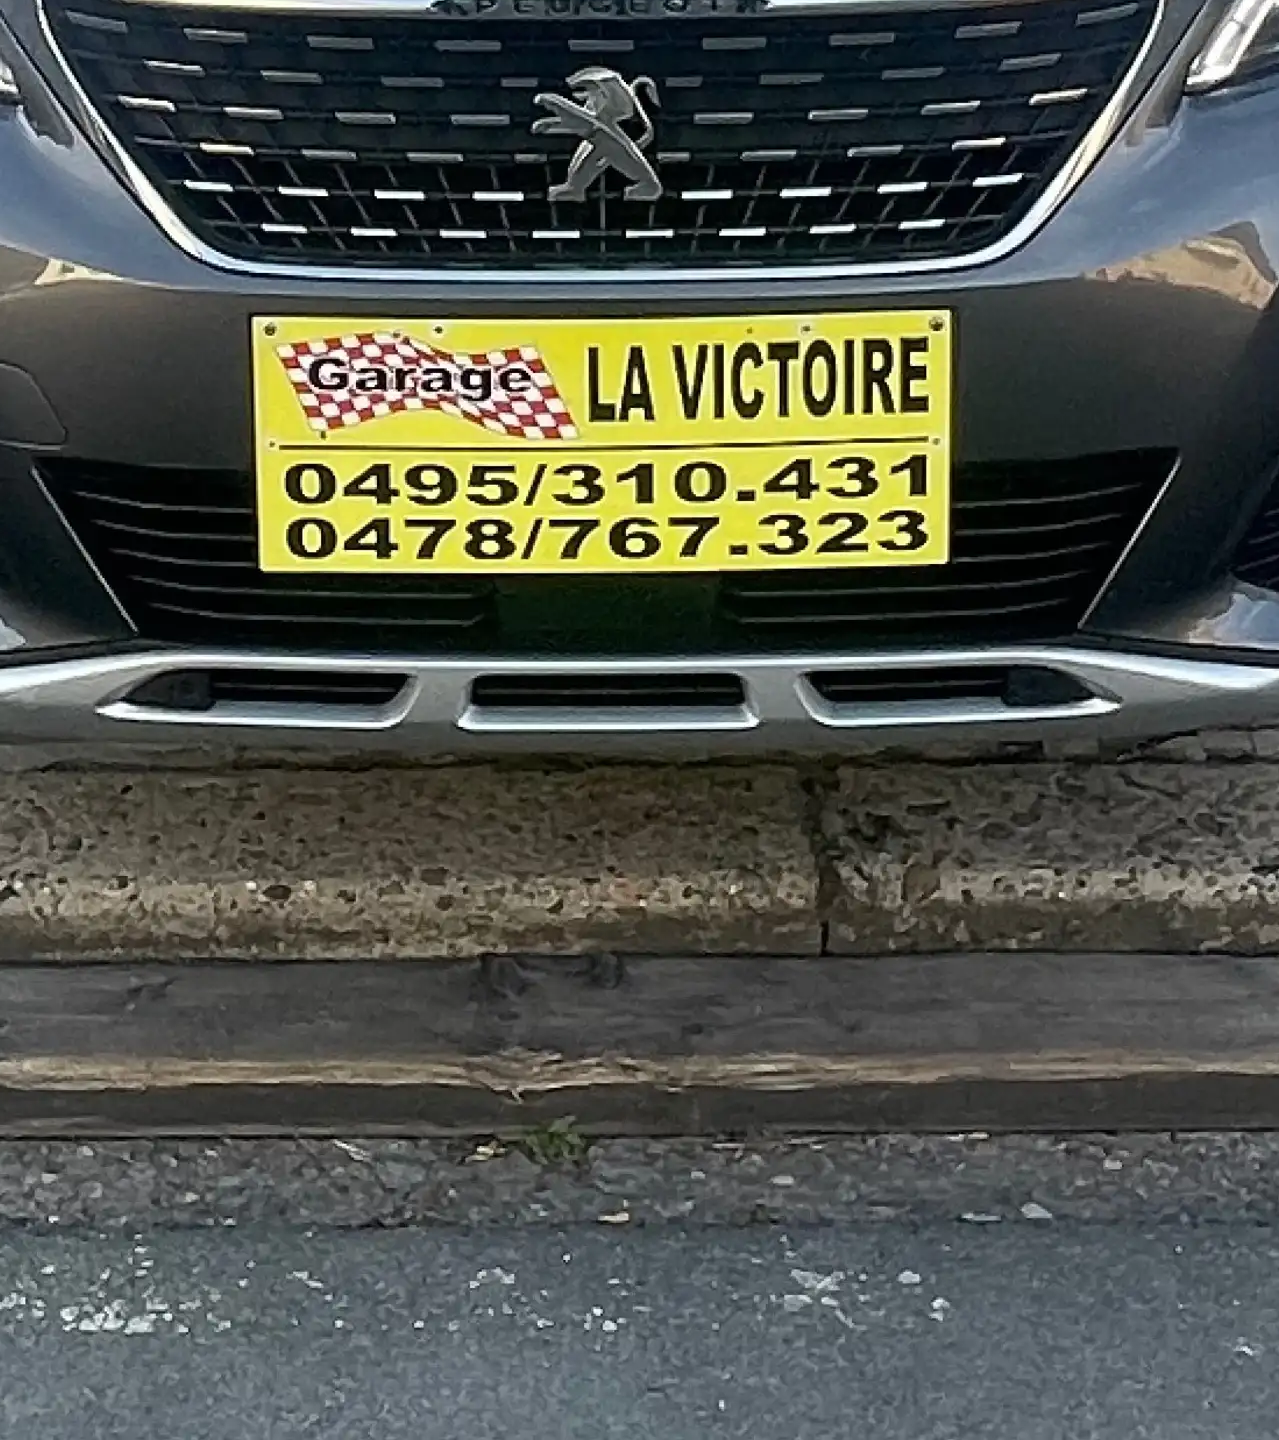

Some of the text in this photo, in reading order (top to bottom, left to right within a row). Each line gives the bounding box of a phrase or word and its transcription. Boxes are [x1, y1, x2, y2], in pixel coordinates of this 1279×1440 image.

[308, 337, 930, 423] Garage LA VICTOIRE
[284, 454, 928, 506] 0495/310.431
[286, 510, 929, 560] 0478/767.323
